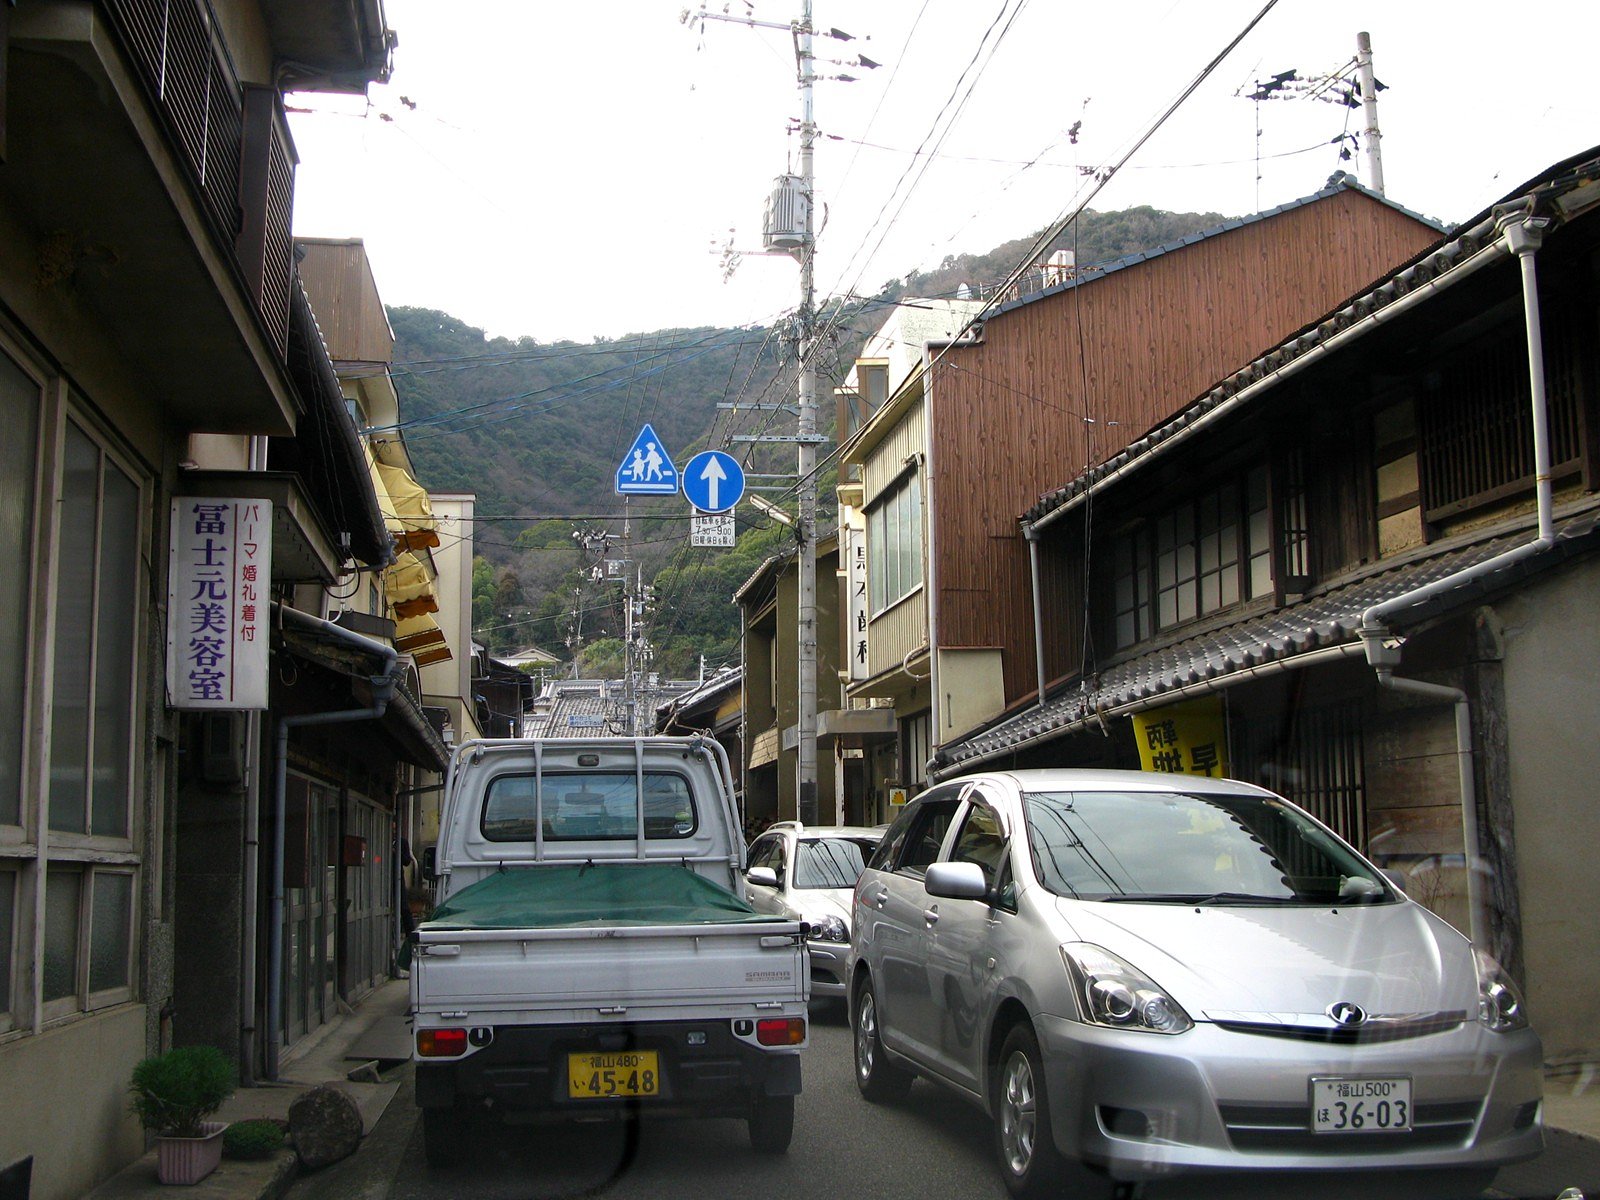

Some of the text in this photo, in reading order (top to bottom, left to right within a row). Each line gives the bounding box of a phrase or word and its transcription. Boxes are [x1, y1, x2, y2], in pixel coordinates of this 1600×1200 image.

[588, 1070, 655, 1094] 45-48
[1317, 1100, 1407, 1129] ほ 36-03
